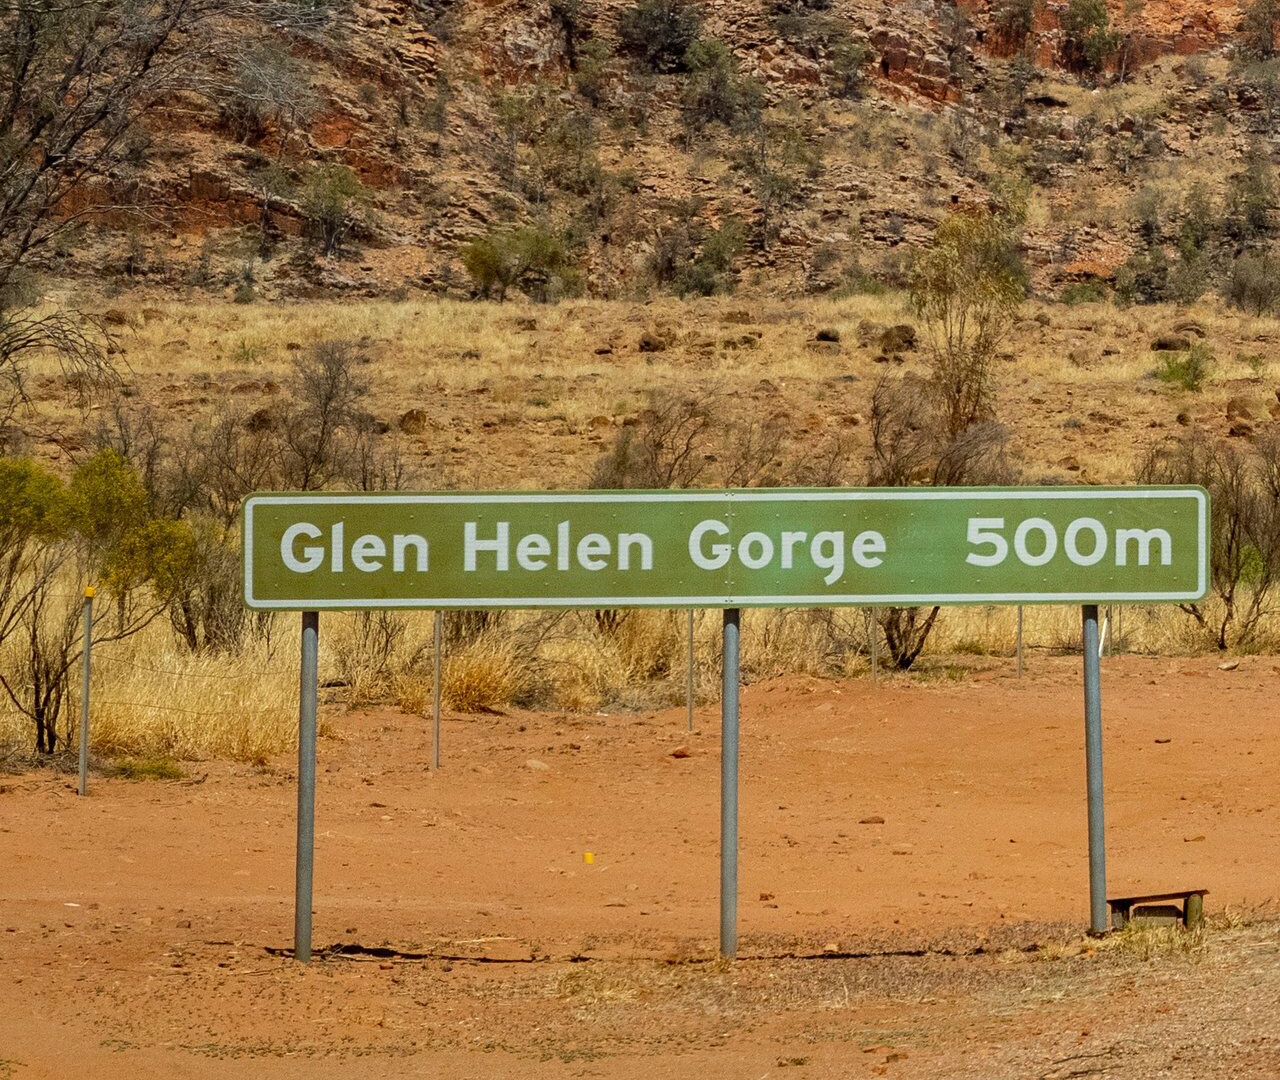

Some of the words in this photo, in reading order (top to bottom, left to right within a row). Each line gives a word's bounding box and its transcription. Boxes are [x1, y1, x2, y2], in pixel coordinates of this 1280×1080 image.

[279, 520, 429, 573] Glen
[463, 519, 654, 572] Helen
[687, 518, 888, 586] Gorge
[964, 516, 1173, 568] 500m
